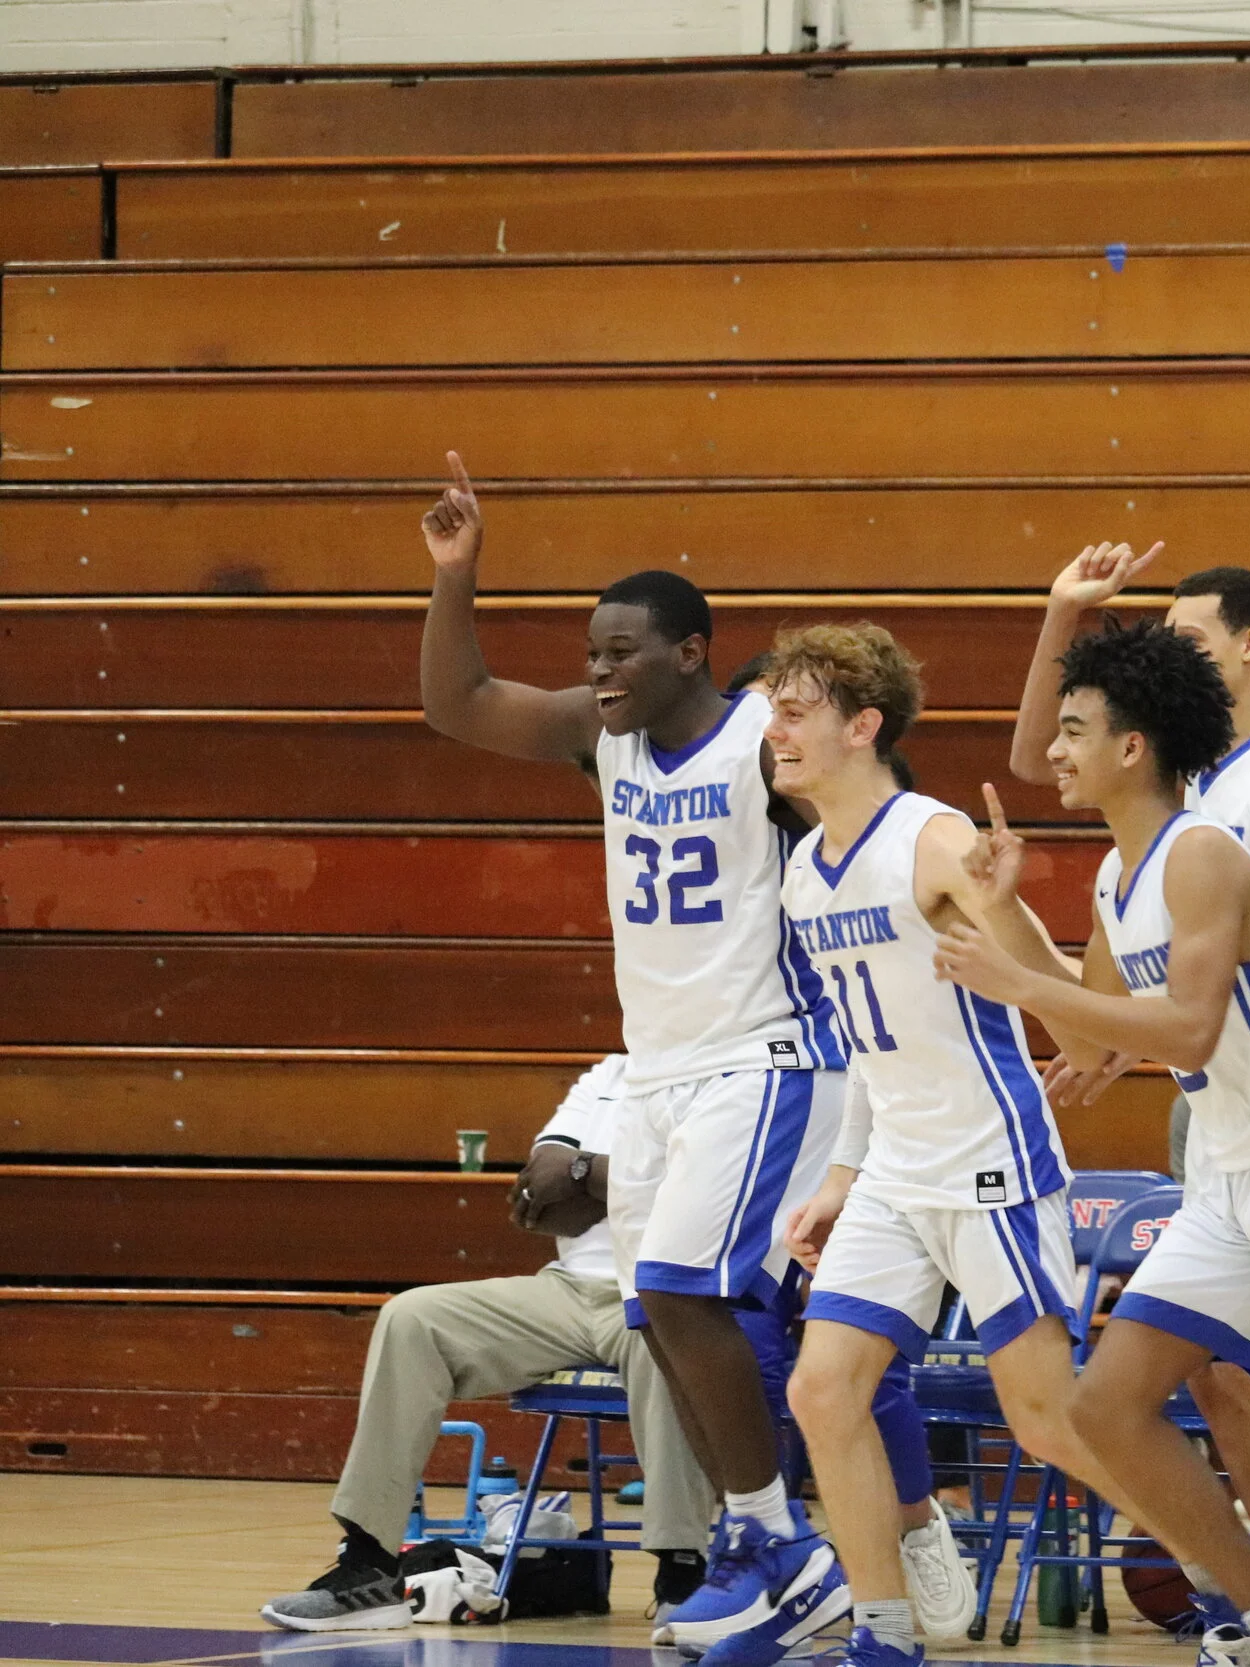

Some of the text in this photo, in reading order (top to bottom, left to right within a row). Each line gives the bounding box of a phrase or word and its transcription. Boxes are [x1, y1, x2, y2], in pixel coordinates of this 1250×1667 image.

[612, 779, 731, 827] STANTON
[625, 834, 724, 925] 32
[830, 960, 898, 1054] 11
[774, 1043, 791, 1052] XL
[984, 1174, 997, 1185] M
